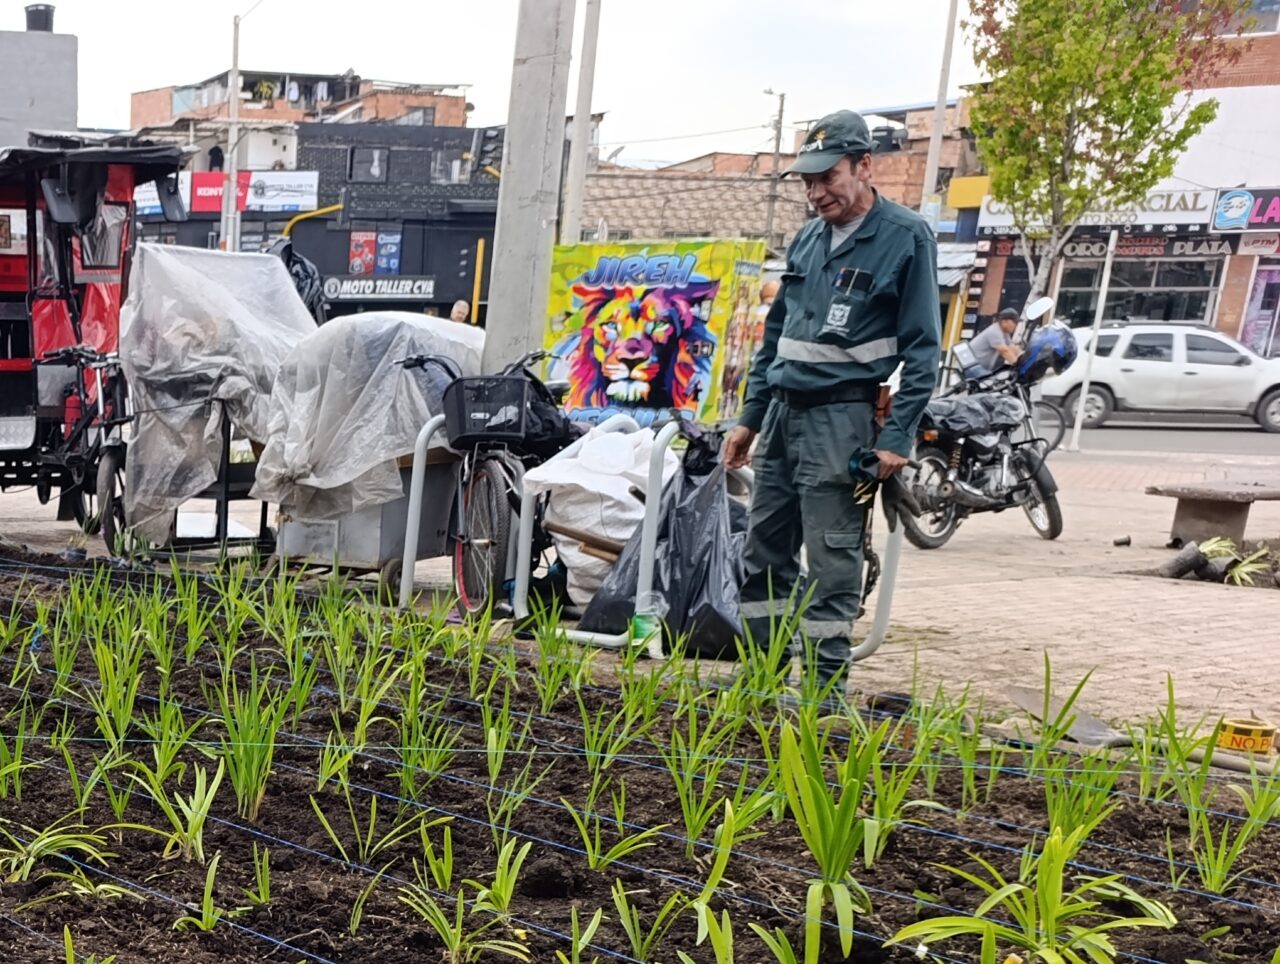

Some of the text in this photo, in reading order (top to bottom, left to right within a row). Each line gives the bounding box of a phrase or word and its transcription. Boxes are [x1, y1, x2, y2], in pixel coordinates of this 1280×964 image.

[196, 186, 244, 197] KONTL
[1063, 242, 1107, 257] ORO
[1173, 240, 1232, 255] PLATA
[581, 254, 698, 289] JIREH
[340, 279, 374, 294] MOTO
[375, 280, 413, 294] TALLER
[1230, 735, 1256, 749] NO
